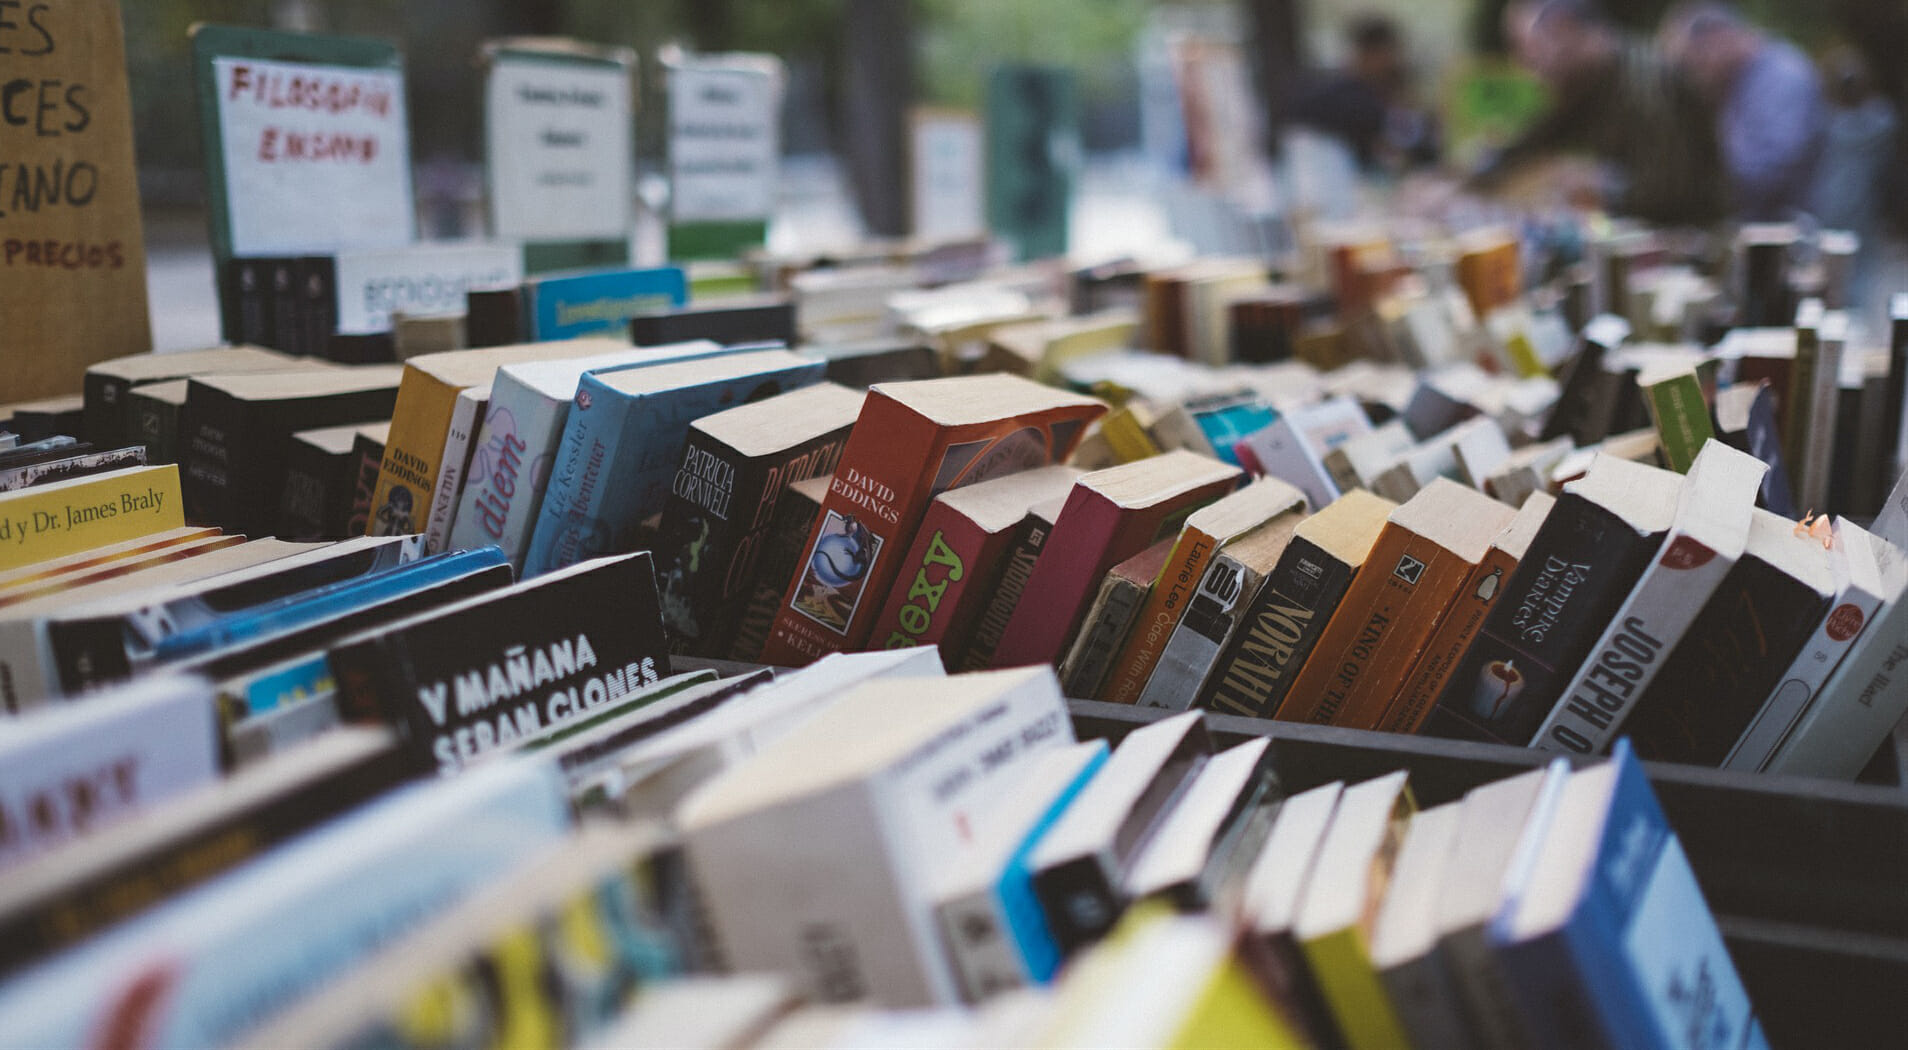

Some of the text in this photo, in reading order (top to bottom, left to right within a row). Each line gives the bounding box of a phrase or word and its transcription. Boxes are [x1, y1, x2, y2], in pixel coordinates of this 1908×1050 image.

[383, 457, 431, 493] EDDINGS
[394, 447, 429, 475] DAVID
[475, 433, 526, 539] diem
[551, 418, 589, 520] Liz Kessler
[683, 444, 736, 494] PATRICIA
[847, 467, 895, 503] DAVID
[16, 520, 28, 544] y
[32, 511, 62, 534] Dr.
[65, 501, 118, 531] James
[120, 488, 164, 514] Braly
[672, 469, 732, 521] CORNWELL
[831, 478, 900, 524] EDDINGS
[1179, 541, 1208, 583] Laurie
[1165, 583, 1187, 610] Lee
[1512, 555, 1568, 629] Diaries
[1520, 564, 1592, 643] Vampire
[1146, 611, 1175, 644] Cider
[1222, 588, 1316, 705] NORAH
[1352, 612, 1389, 661] KING
[418, 633, 597, 727] Y MAÑANA
[1128, 646, 1152, 675] With
[1338, 661, 1359, 688] OF
[1566, 615, 1663, 731] JOSEPH
[547, 656, 660, 725] CLONES
